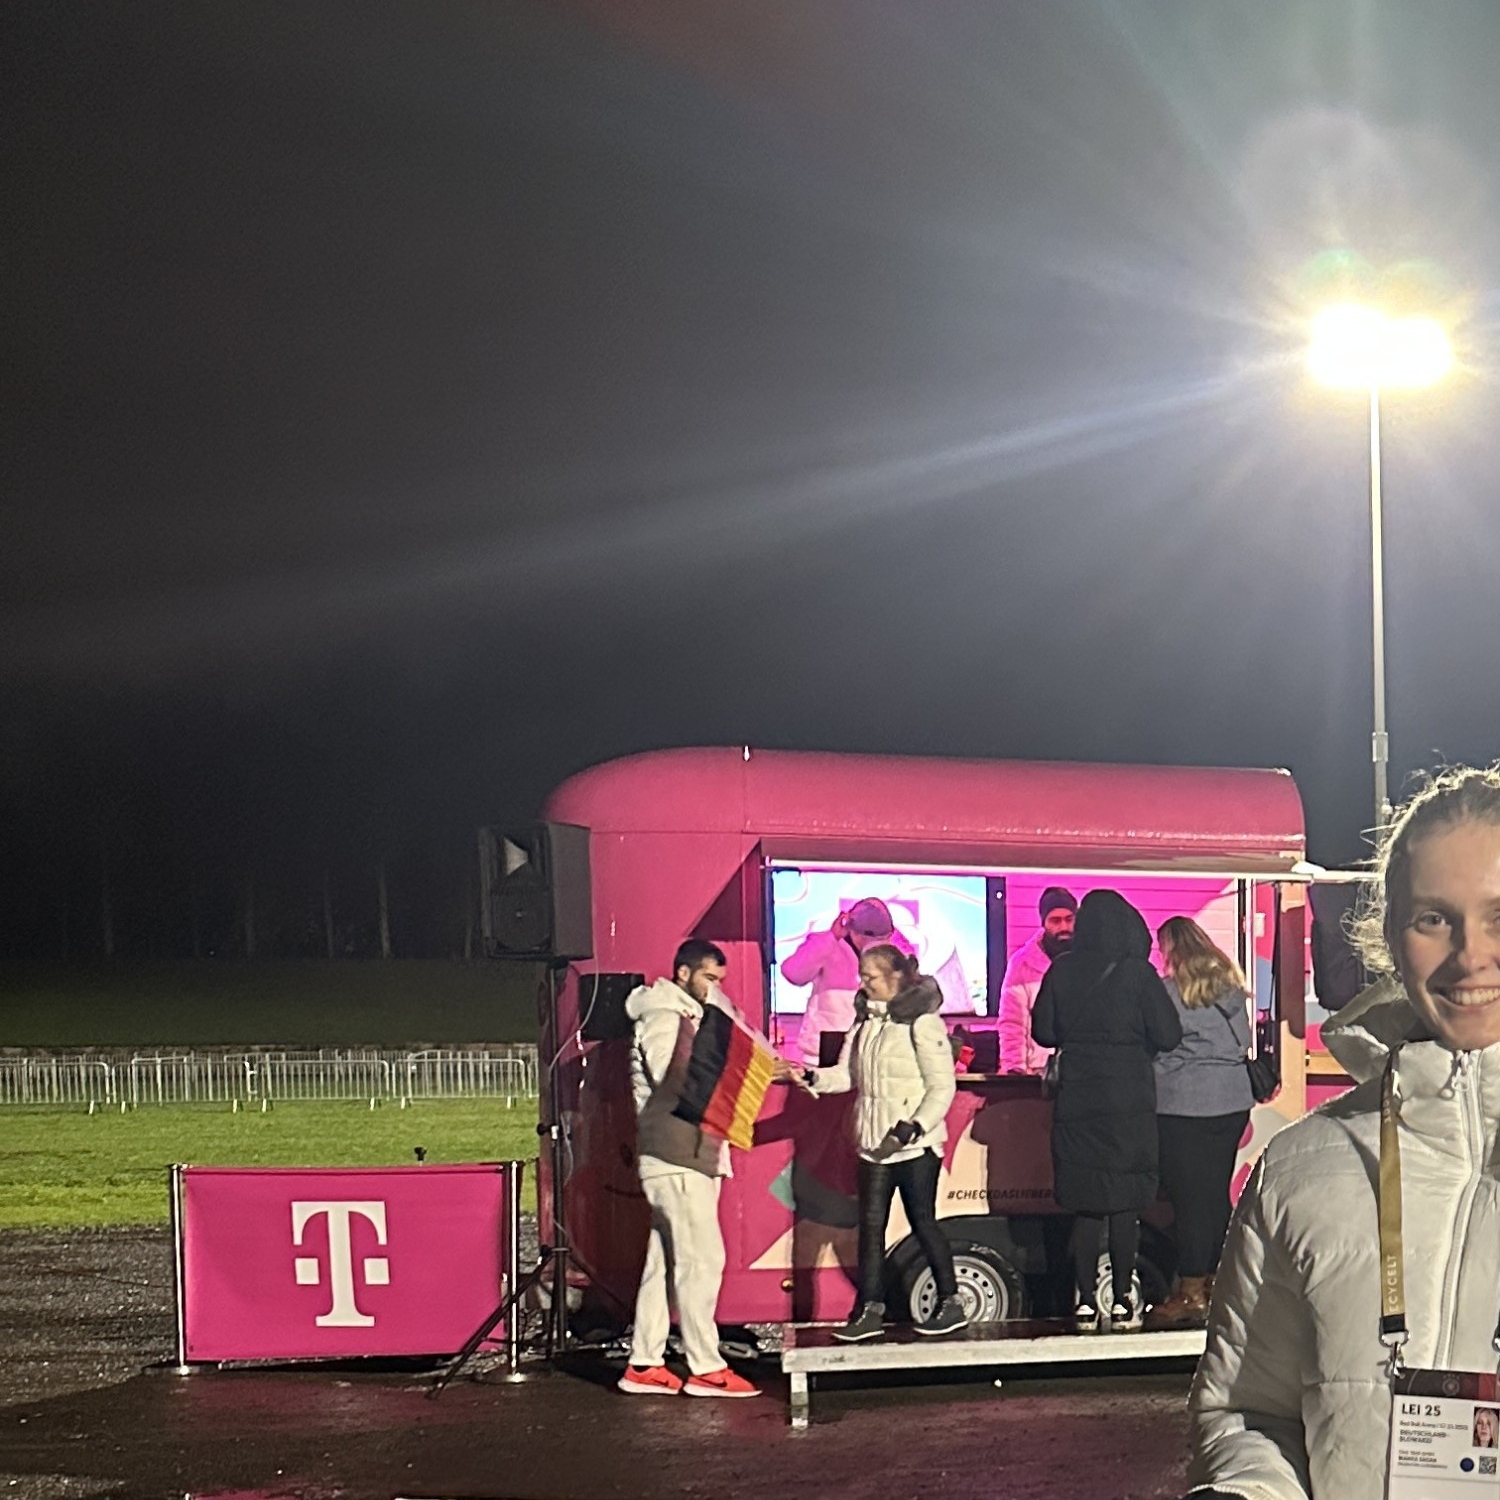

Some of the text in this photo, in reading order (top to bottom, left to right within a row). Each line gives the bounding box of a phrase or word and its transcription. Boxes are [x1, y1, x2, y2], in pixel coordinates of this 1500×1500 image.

[291, 1200, 390, 1327] T
[1386, 1254, 1399, 1313] ECYCELT
[1401, 1403, 1441, 1417] LEI 25
